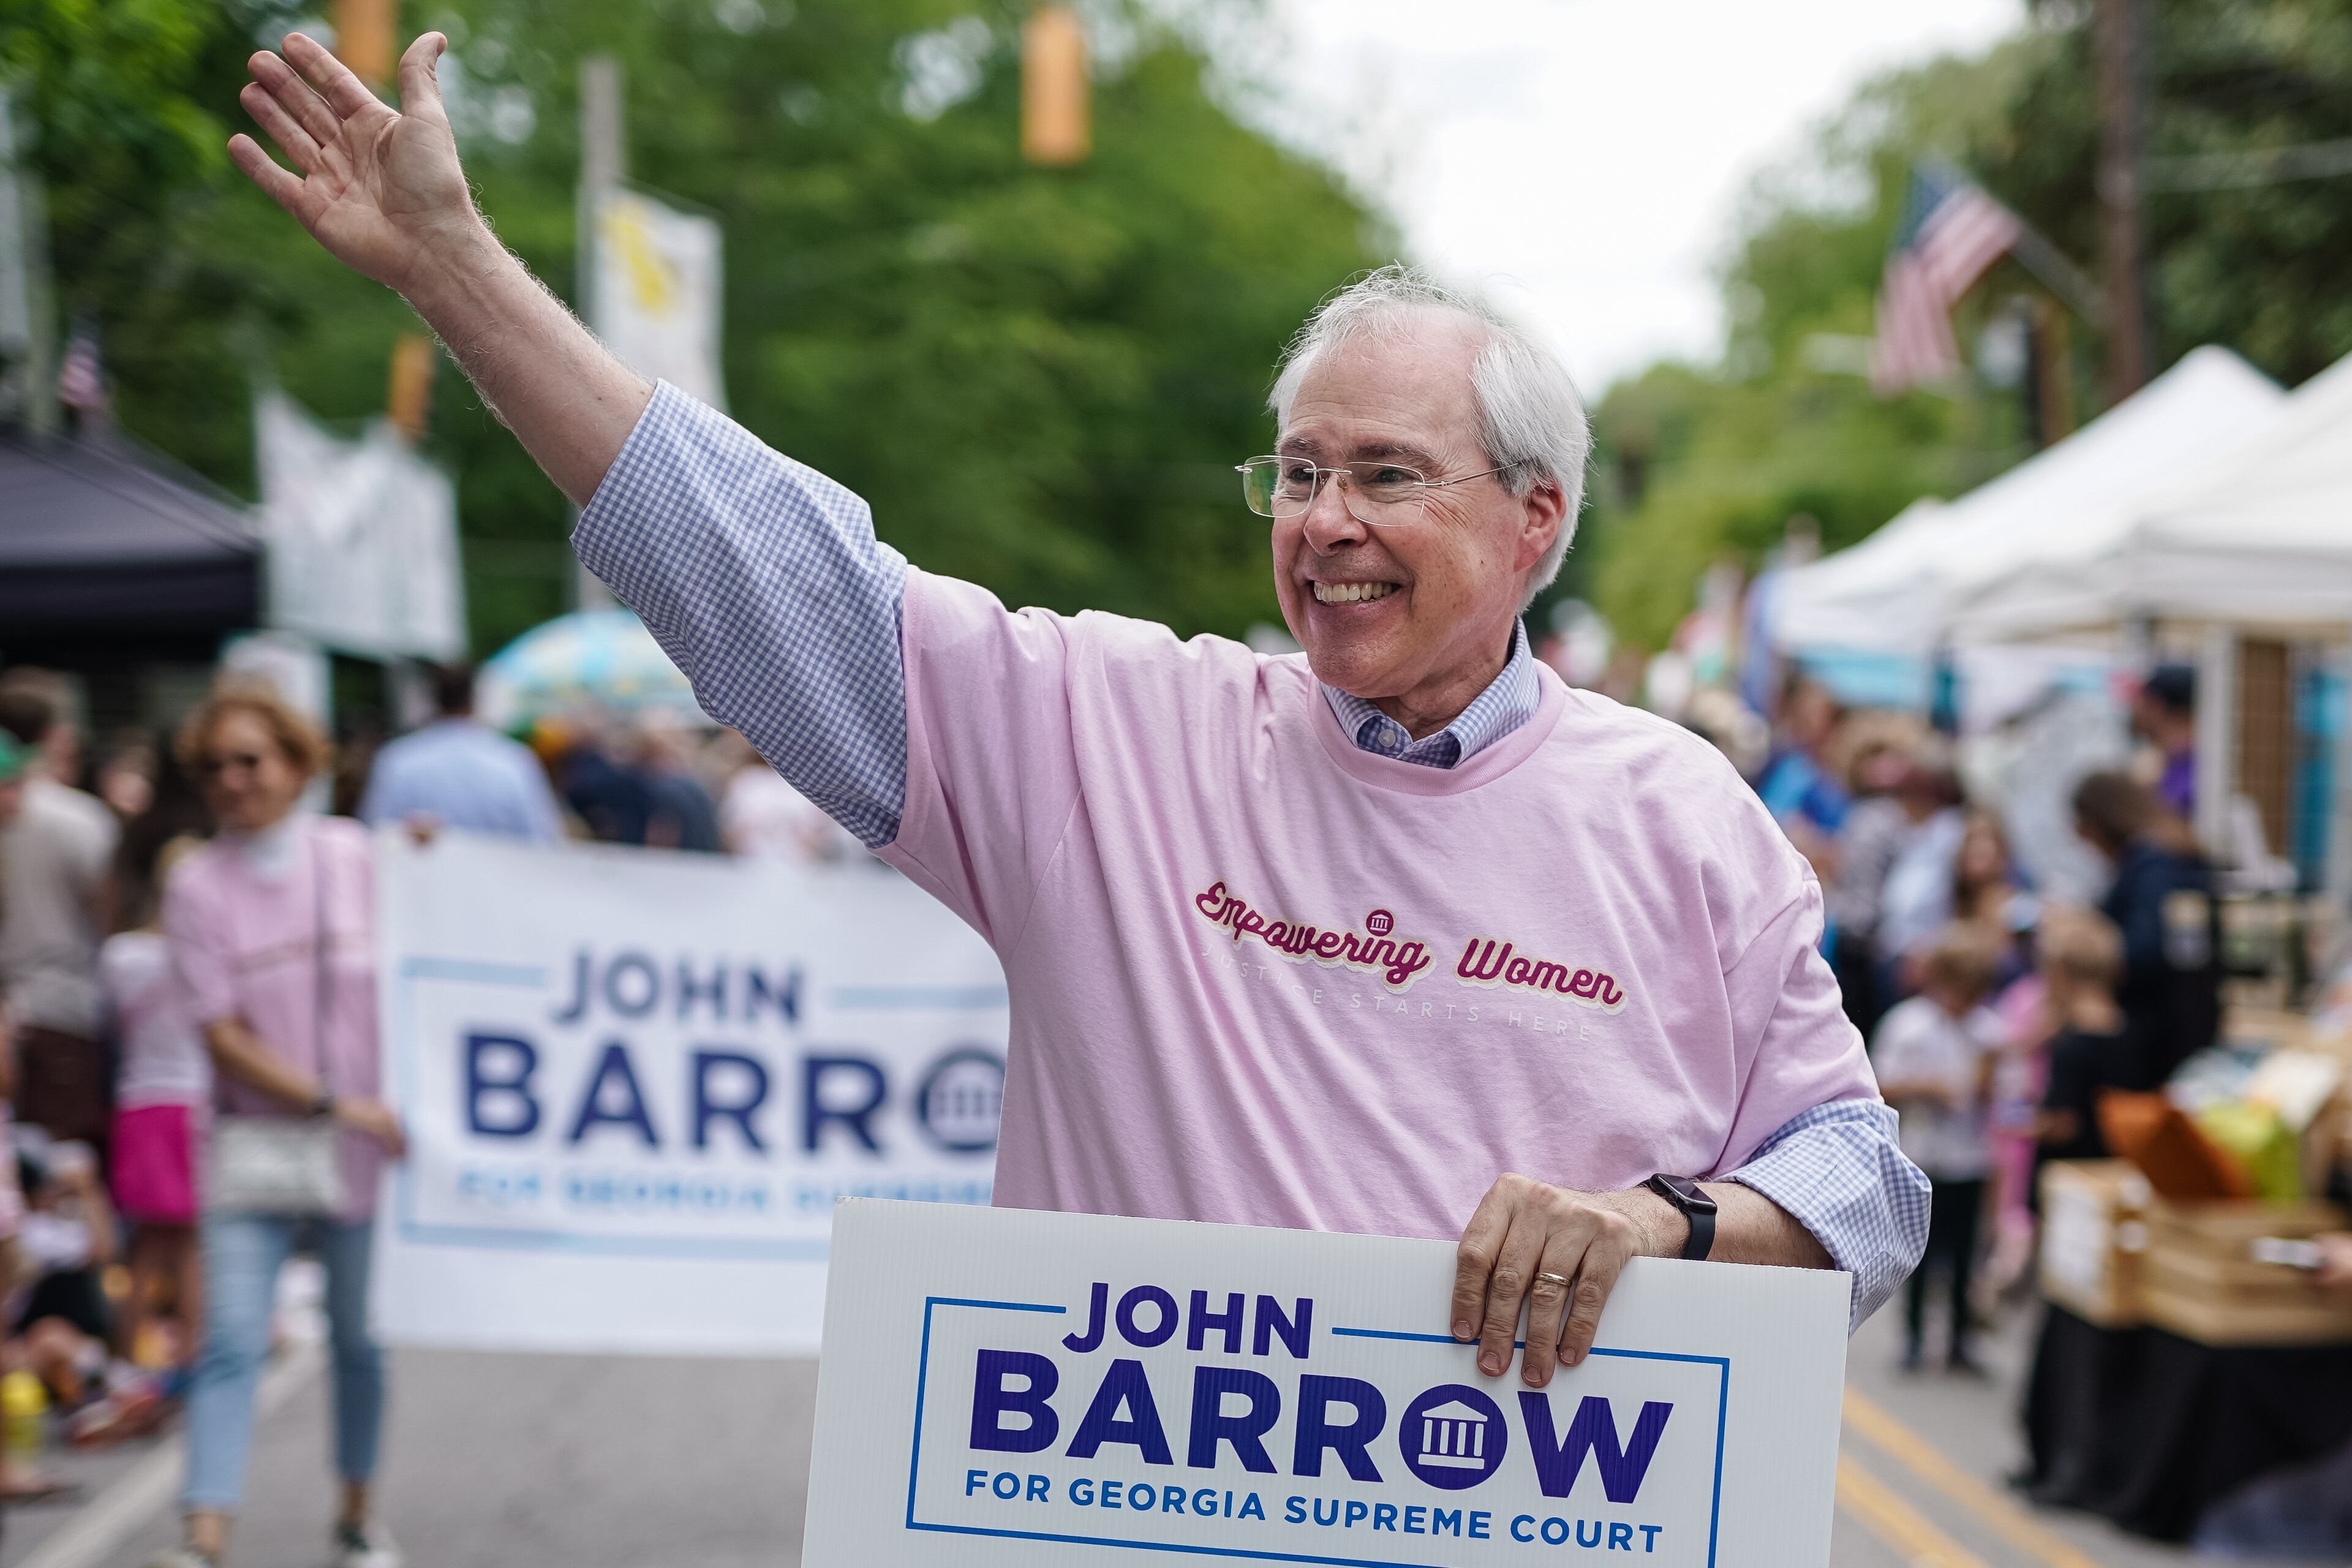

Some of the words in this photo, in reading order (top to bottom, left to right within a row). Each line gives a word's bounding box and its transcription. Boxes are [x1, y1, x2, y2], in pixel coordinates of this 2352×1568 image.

[553, 949, 805, 1025] JOHN
[1194, 880, 1431, 986] Empowering
[1456, 938, 1624, 1006] Women
[1201, 944, 1323, 1005] JUSTICE
[1349, 993, 1480, 1023] STARTS
[1507, 1012, 1591, 1041] HERE
[461, 1028, 1005, 1158] BARRO
[1061, 1282, 1314, 1360] JOHN
[969, 1348, 1675, 1504] BARROW
[965, 1469, 1050, 1502] FOR
[1069, 1478, 1265, 1521] GEORGIA
[1284, 1496, 1491, 1539] SUPREME
[1510, 1514, 1664, 1553] COURT
